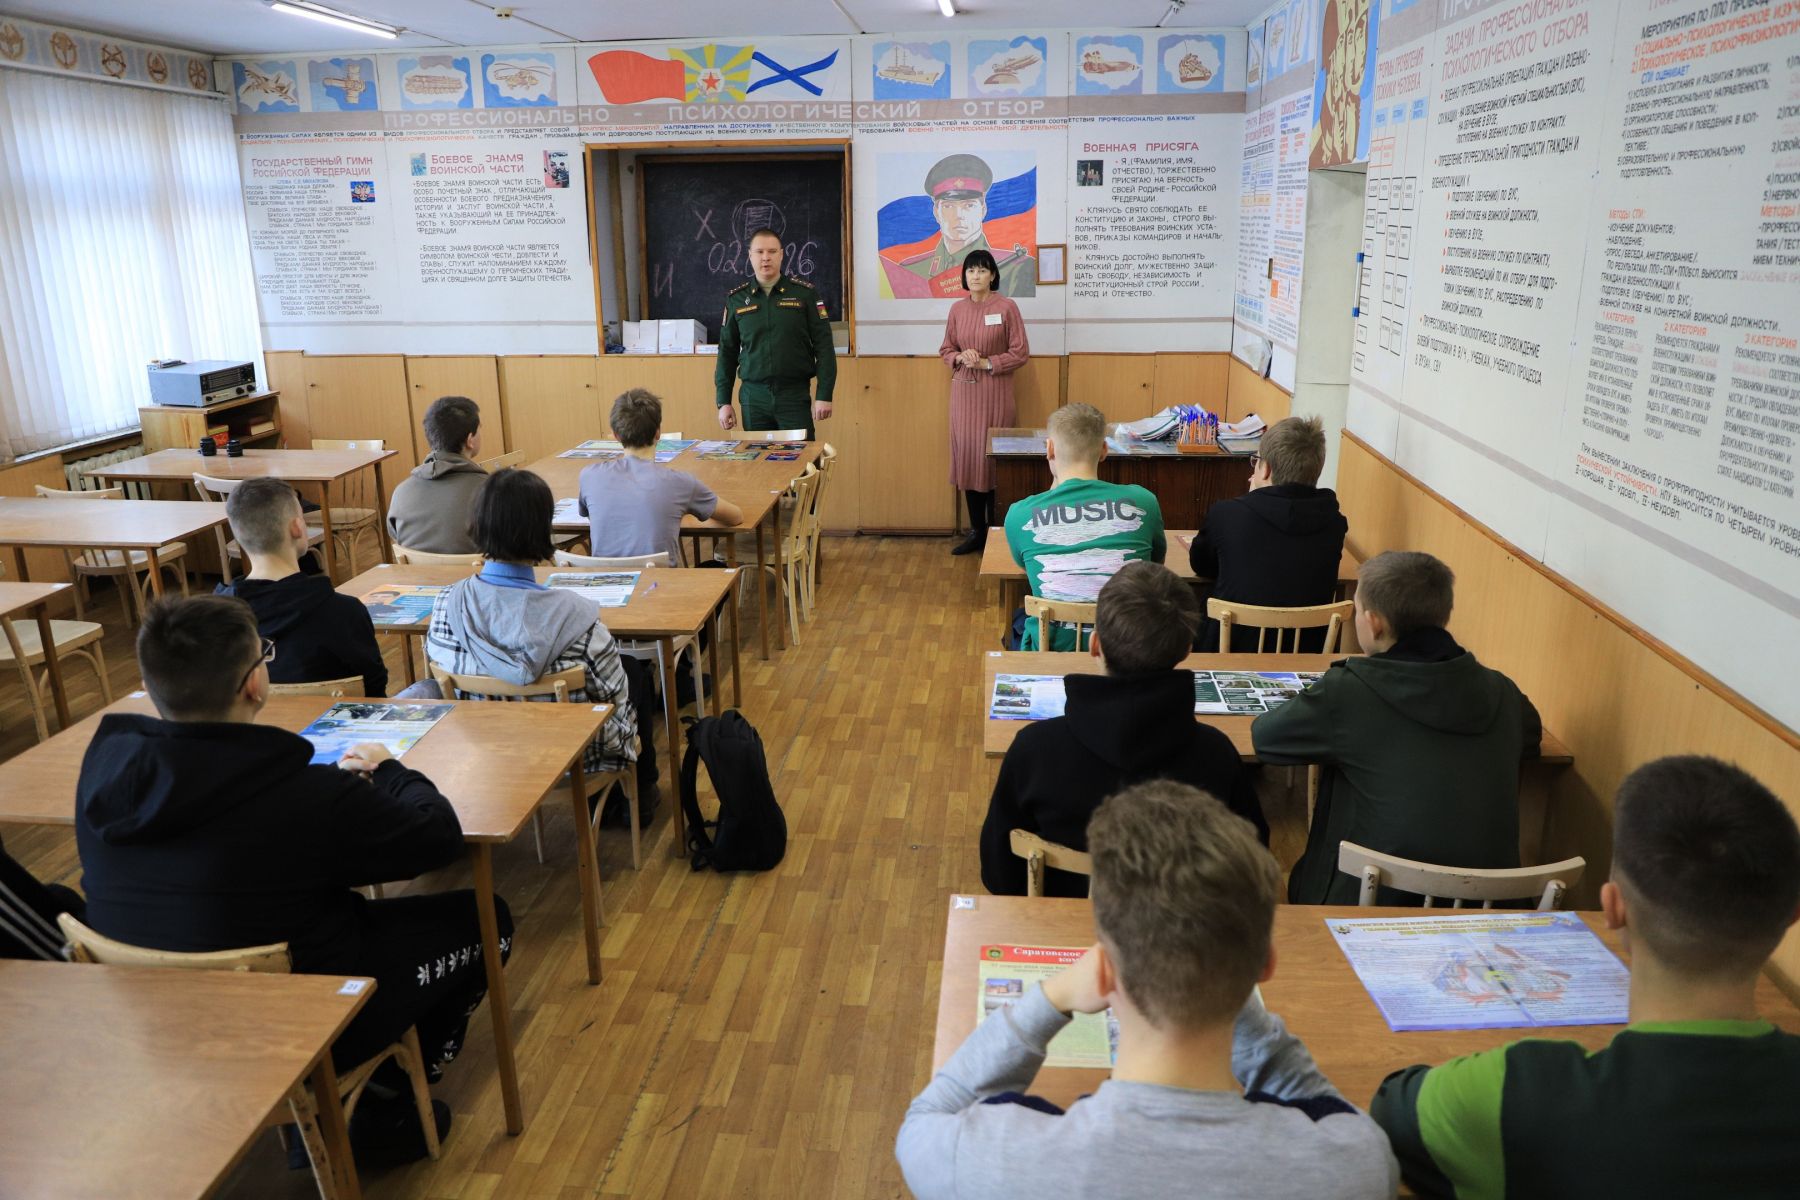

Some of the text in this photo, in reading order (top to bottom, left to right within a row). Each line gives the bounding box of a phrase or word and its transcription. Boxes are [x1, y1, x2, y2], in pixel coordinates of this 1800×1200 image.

[1641, 12, 1695, 39] МЕРОПРИЯТИЯ
[1698, 8, 1708, 21] ПО
[1543, 11, 1590, 48] ОТБОРА
[1535, 56, 1559, 77] ГРАЖДАН
[384, 100, 1044, 128] ПРОФЕССИОНАЛЬНО ПСИХОЛОГИЧЕСКИЙ ОТБОР
[1083, 142, 1198, 152] ВОЕННАЯ ПРИСЯГА
[252, 156, 373, 166] ГОСУДАРСТВЕННЫЙ ГИМН
[431, 153, 523, 164] БОЕВОЕ ЗНАМЯ
[254, 167, 370, 177] РОССИЙСКОЙ ФЕДЕРАЦИИ
[430, 164, 524, 174] ВОИНСКОЙ ЧАСТИ
[468, 179, 499, 187] ВОИНСКОЙ
[1166, 176, 1204, 184] ВЕРНОСТЬ
[438, 187, 472, 195] ПОЧЕТНЫЙ
[499, 186, 545, 194] ОТЛИЧАЮЩИЙ
[1111, 183, 1216, 194] СВОЕЙ РОДИНЕ РОССИЙСКОЙ
[1087, 206, 1122, 214] КЛЯНУСЬ
[1149, 205, 1192, 213] СОБЛЮДАТЬ
[1075, 215, 1126, 224] КОНСТИТУЦИЮ
[1157, 223, 1193, 231] ВОИНСКИХ
[1133, 233, 1181, 241] КОМАНДИРОВ
[1085, 252, 1204, 262] КЛЯНУСЬ ДОСТОЙНО ВЫПОЛНЯТЬ
[1074, 262, 1111, 270] ВОИНСКИЙ
[1701, 268, 1738, 280] ВЫНОСИТСЯ
[1074, 279, 1143, 288] КОНСТИТУЦИОННЫЙ
[1146, 279, 1167, 287] СТРОЙ
[1653, 306, 1692, 320] КОНКРЕТНОЙ
[1694, 311, 1728, 325] ВОИНСКОЙ
[1670, 324, 1707, 337] КАТЕГОРИЯ
[1751, 334, 1798, 349] КАТЕГОРИЯ
[1621, 460, 1657, 482] ЗАКЛЮЧЕНИЯ
[1664, 478, 1726, 510] ПРОФПРИГОДНОСТИ
[1727, 502, 1776, 529] УЧИТЫВАЕТСЯ
[1032, 498, 1137, 529] MUSIC
[1673, 496, 1713, 519] ВЫНОСИТСЯ
[1715, 512, 1725, 524] ПО
[1728, 517, 1765, 541] ЧЕТЫРЕМ
[1013, 947, 1081, 957] Саратовское
